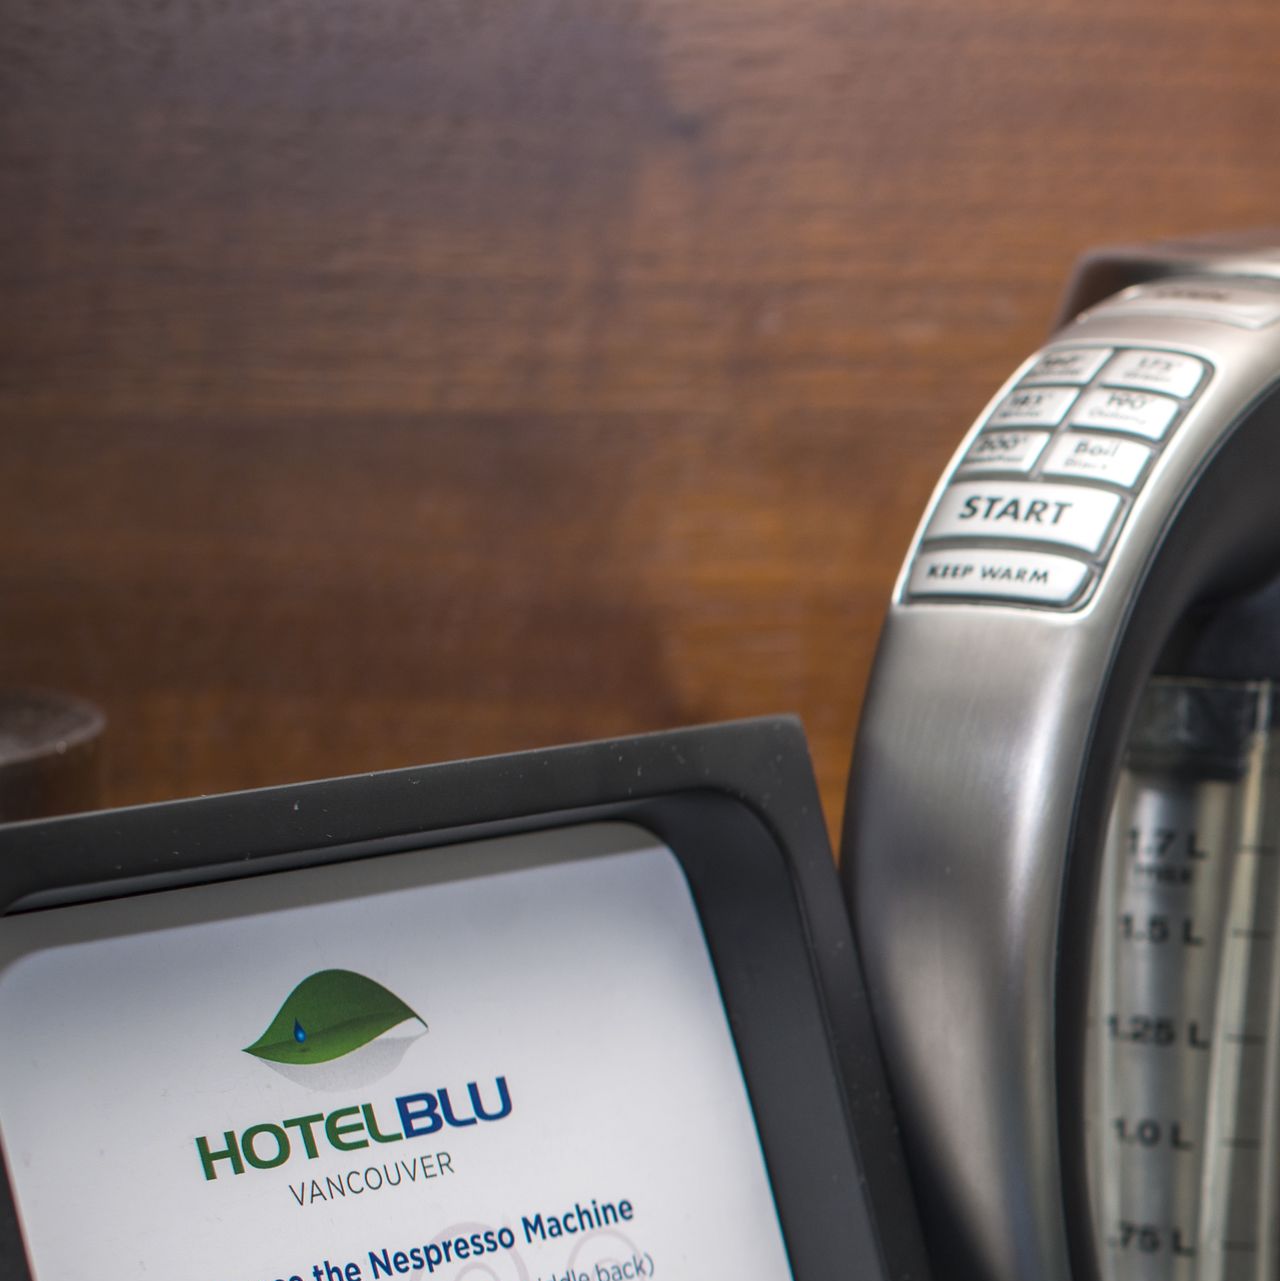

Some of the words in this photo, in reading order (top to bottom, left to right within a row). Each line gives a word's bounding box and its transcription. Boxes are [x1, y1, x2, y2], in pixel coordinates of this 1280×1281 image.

[957, 494, 1073, 526] START
[926, 563, 974, 580] KEEP
[980, 565, 1050, 585] WARM
[194, 1075, 514, 1182] HOTELBLU
[1112, 1117, 1162, 1147] 1.0
[288, 1150, 456, 1206] VANCOUVER
[369, 1224, 516, 1280] Nespresso
[520, 1198, 635, 1244] Machine
